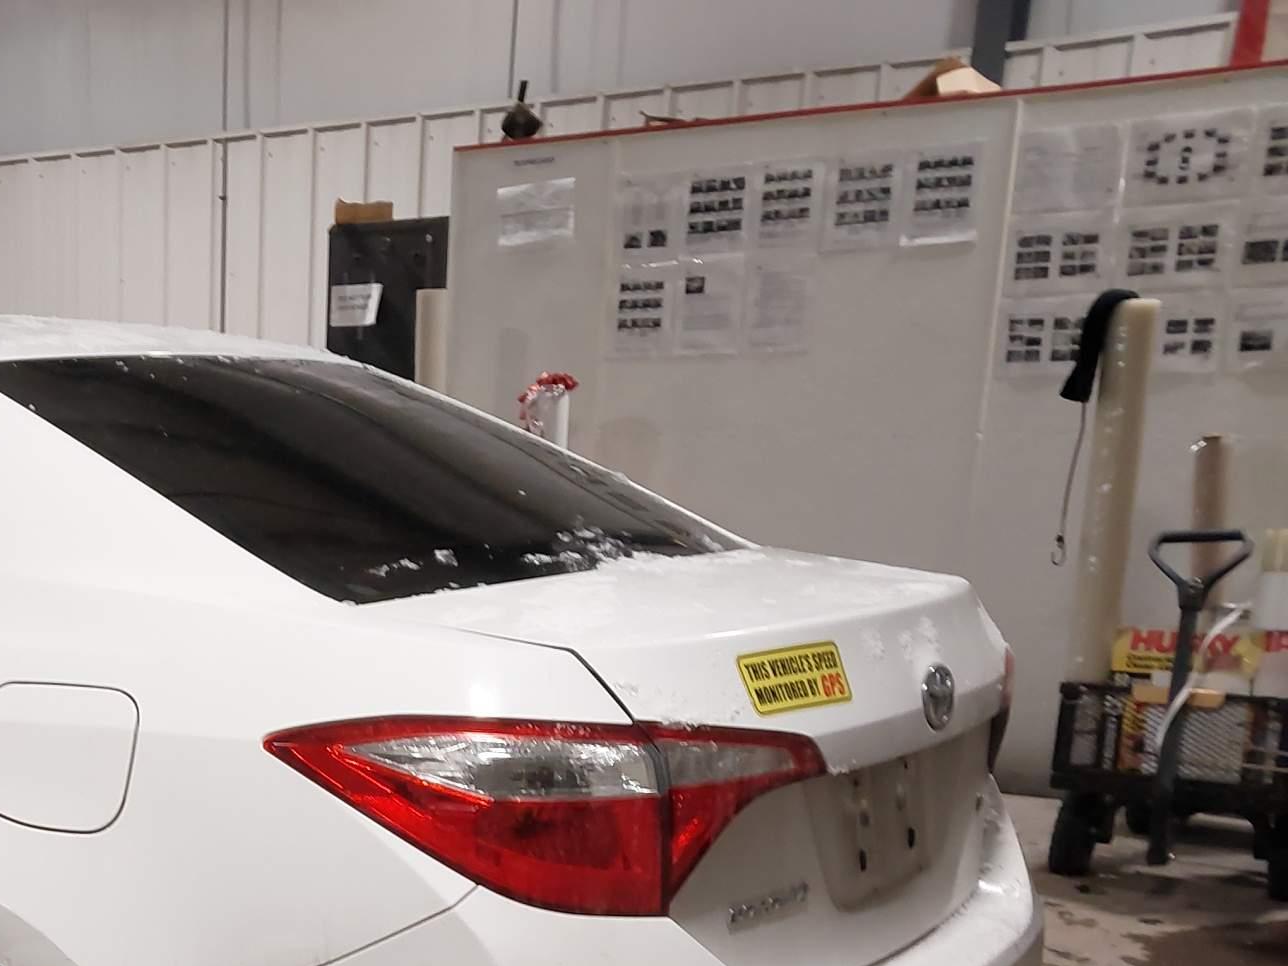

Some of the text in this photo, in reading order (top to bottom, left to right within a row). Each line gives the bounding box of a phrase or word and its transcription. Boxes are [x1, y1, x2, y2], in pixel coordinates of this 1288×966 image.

[744, 650, 838, 682] THIS VEHICLE'S SPEED
[754, 672, 846, 706] MONITORED BY GPS
